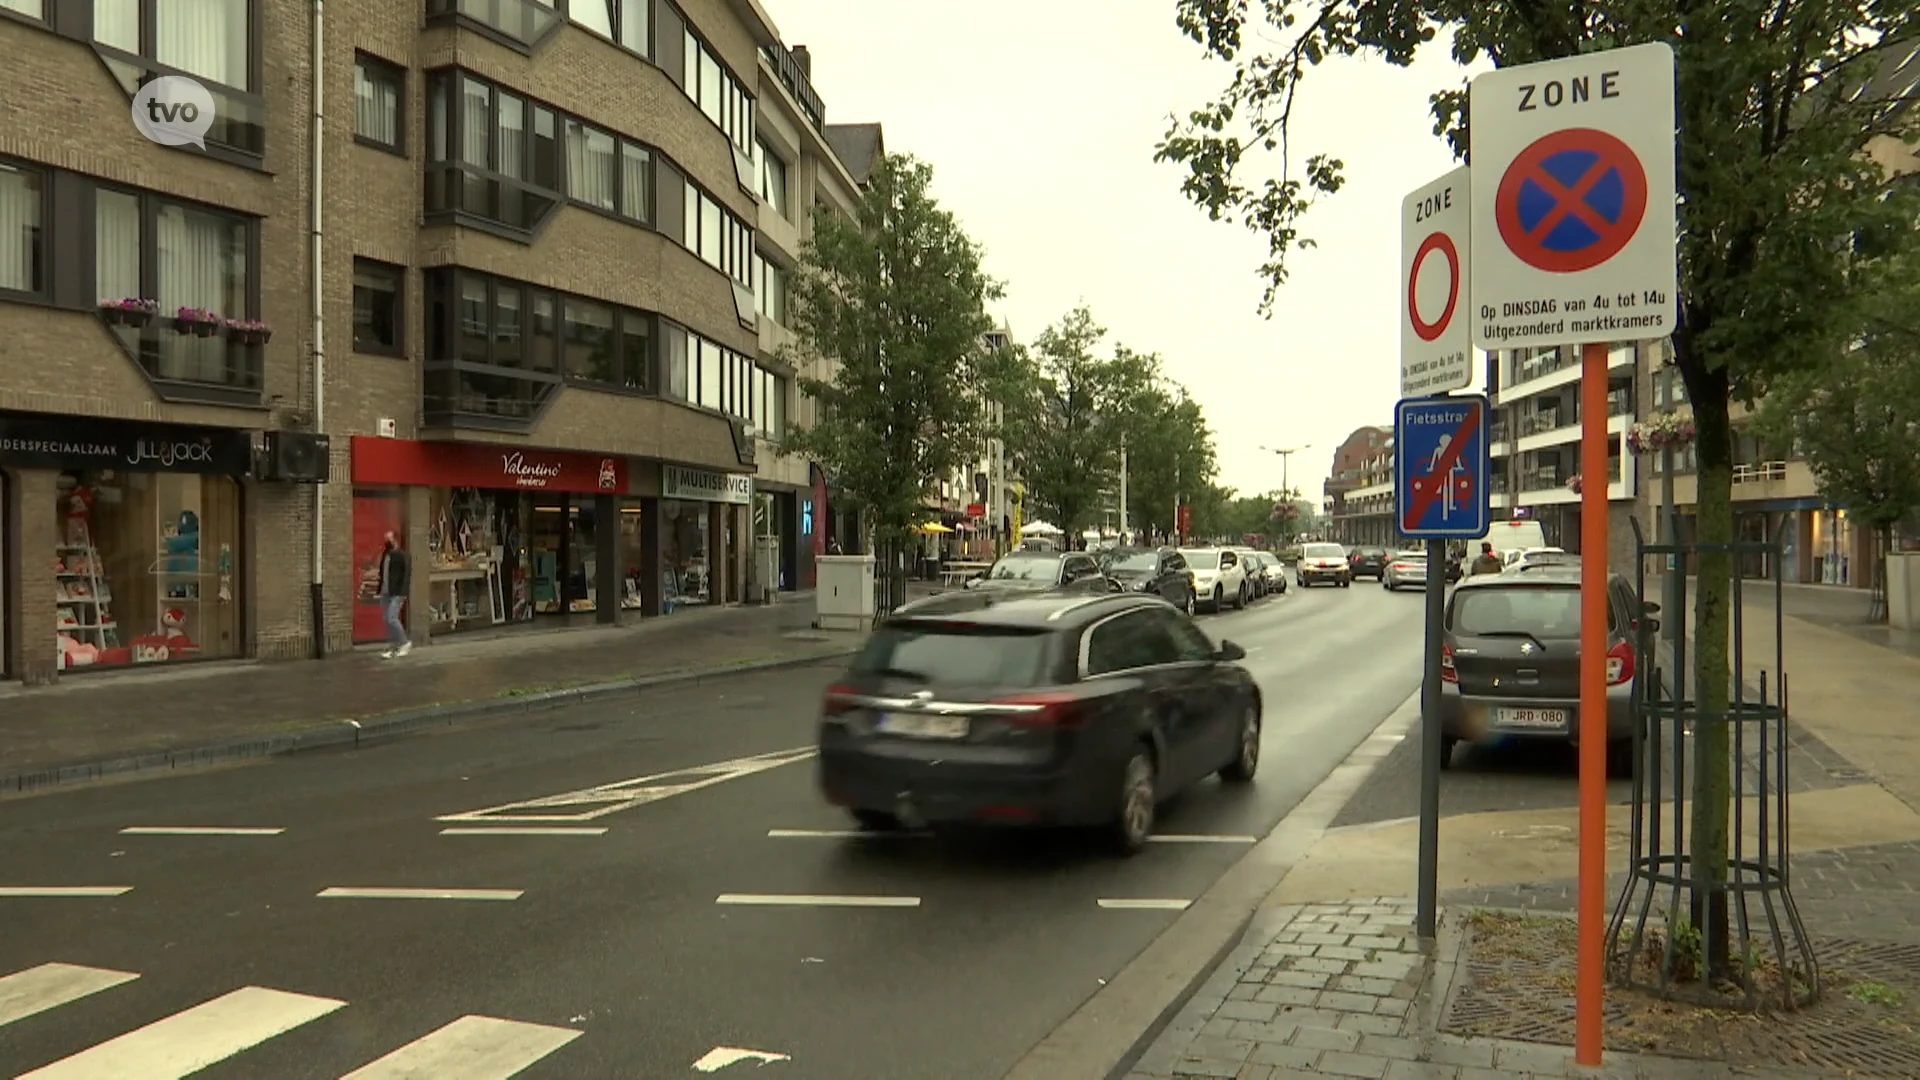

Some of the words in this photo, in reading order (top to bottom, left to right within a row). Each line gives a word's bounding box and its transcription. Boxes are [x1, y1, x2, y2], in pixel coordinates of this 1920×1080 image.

[1518, 71, 1619, 112] ZONE
[1416, 187, 1452, 224] ZONE
[1481, 304, 1496, 322] Op
[1503, 299, 1557, 317] DINSDAG
[1564, 301, 1586, 313] van
[1593, 295, 1610, 309] 4u
[1618, 292, 1636, 307] tot
[1644, 290, 1666, 305] 14u
[1484, 319, 1564, 341] Uitgezonderd
[1571, 314, 1663, 333] marktkramers
[1406, 410, 1468, 425] Fietsstra
[502, 451, 561, 477] Valentino
[680, 469, 748, 494] MULTISERVICE
